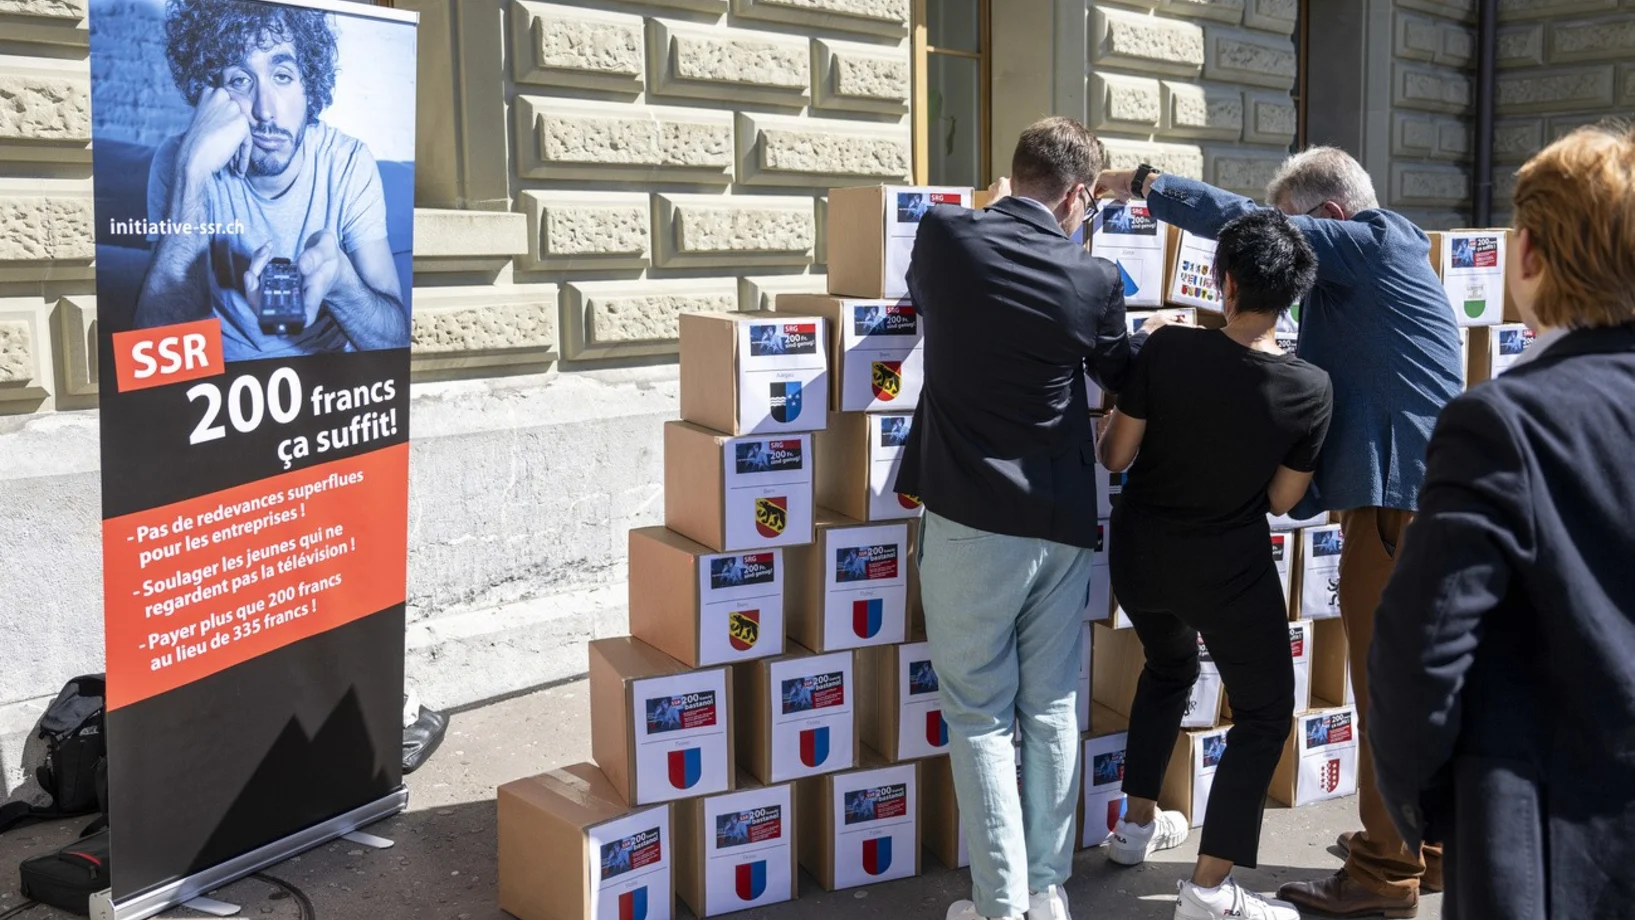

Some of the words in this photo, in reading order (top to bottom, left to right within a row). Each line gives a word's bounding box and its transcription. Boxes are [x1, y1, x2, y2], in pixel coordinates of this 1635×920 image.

[1132, 216, 1145, 224] 200
[110, 218, 244, 235] initiative-ssr.ch
[887, 316, 901, 324] 200
[785, 334, 801, 344] 200
[797, 339, 815, 348] genug!
[131, 333, 209, 378] SSR
[186, 367, 302, 445] 200
[310, 379, 396, 416] francs
[278, 434, 309, 469] ça
[316, 408, 398, 448] suffit!
[771, 450, 787, 460] 200
[782, 456, 800, 464] genug!
[172, 516, 193, 532] de
[197, 492, 284, 526] redevances
[288, 469, 364, 502] superflues
[139, 541, 182, 568] pour
[186, 532, 208, 552] les
[212, 509, 298, 544] entreprises
[222, 552, 244, 574] les
[245, 538, 296, 568] jeunes
[300, 528, 323, 553] qui
[326, 524, 344, 540] ne
[868, 546, 884, 556] 200
[744, 564, 760, 574] 200
[756, 568, 772, 578] genug!
[145, 576, 229, 618] regardent
[232, 572, 258, 594] pas
[261, 562, 274, 580] la
[278, 541, 348, 576] télévision
[200, 611, 233, 635] plus
[236, 598, 264, 622] que
[268, 586, 295, 608] 200
[298, 572, 342, 597] francs
[150, 654, 172, 671] au
[176, 641, 207, 662] lieu
[210, 632, 230, 650] de
[233, 620, 260, 642] 335
[264, 606, 308, 630] francs
[814, 674, 829, 686] 200
[682, 694, 698, 704] 200
[1332, 714, 1344, 724] 200
[876, 786, 892, 798] 200
[750, 808, 766, 820] 200
[631, 832, 646, 846] 200
[1224, 908, 1240, 916] FILA
